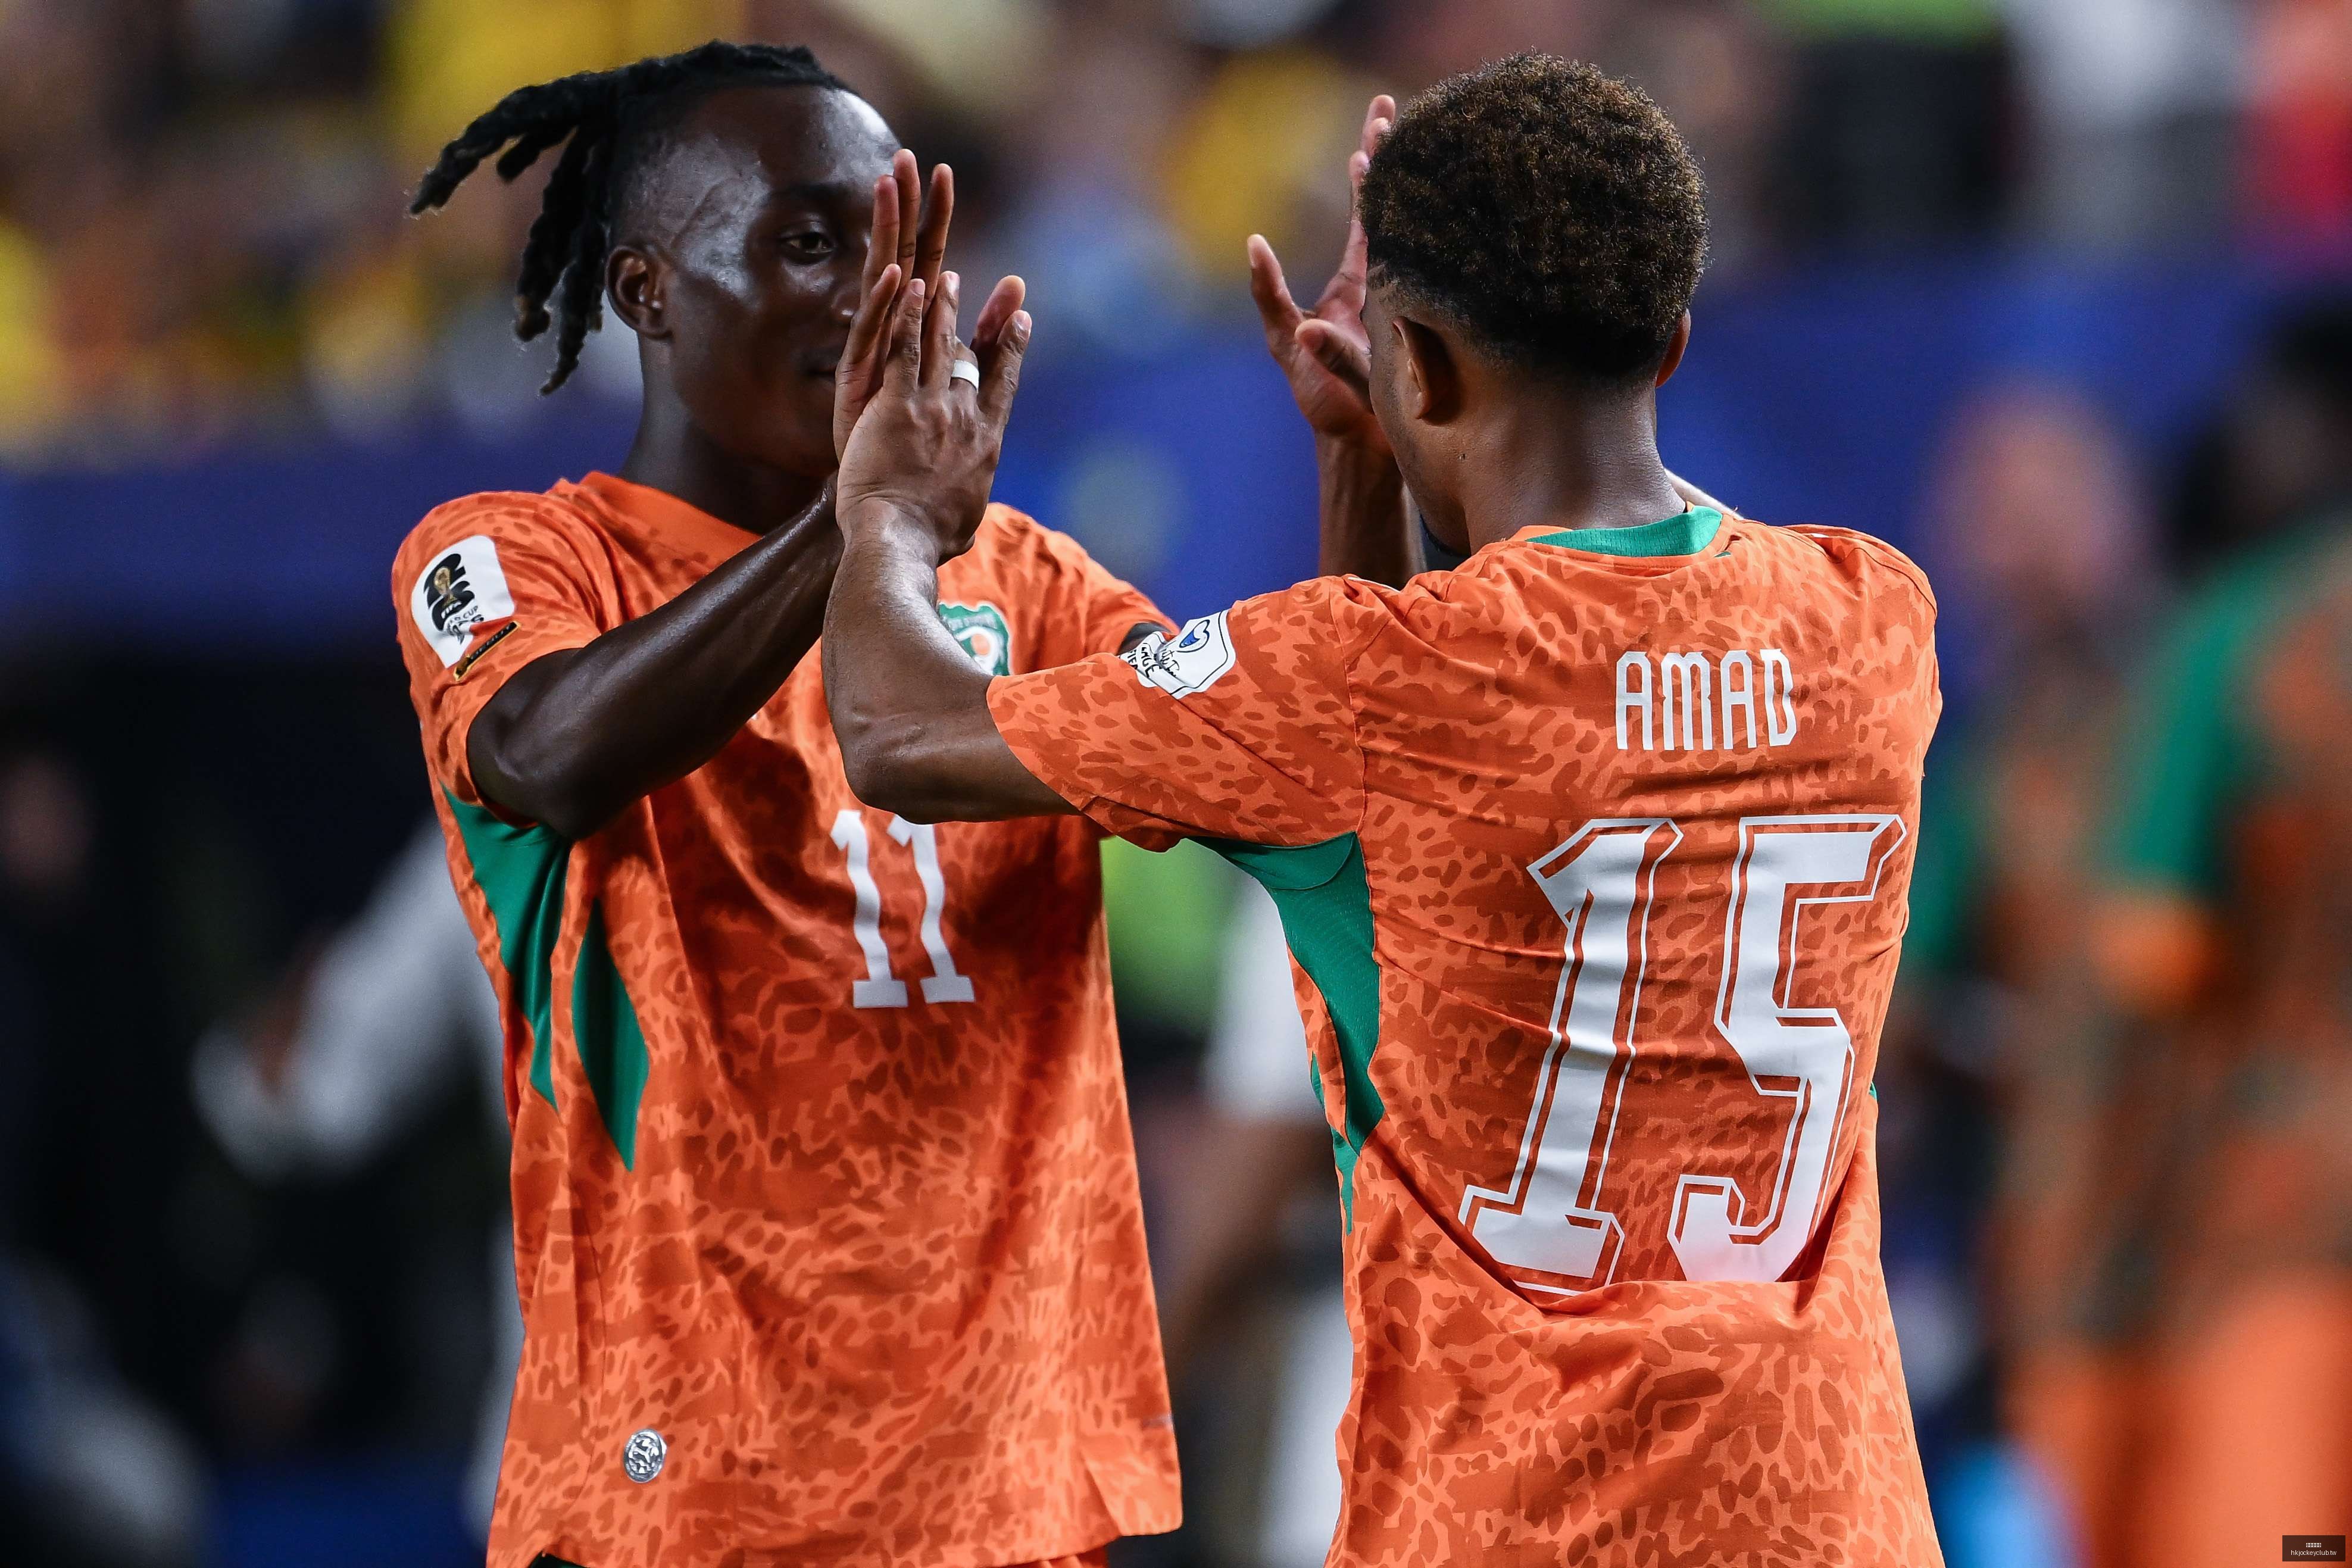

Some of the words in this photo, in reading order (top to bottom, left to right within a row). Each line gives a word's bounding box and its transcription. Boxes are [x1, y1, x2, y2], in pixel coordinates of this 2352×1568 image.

[1616, 648, 1797, 751] AMAD
[830, 810, 976, 1008] 11
[1458, 814, 1907, 1296] 15
